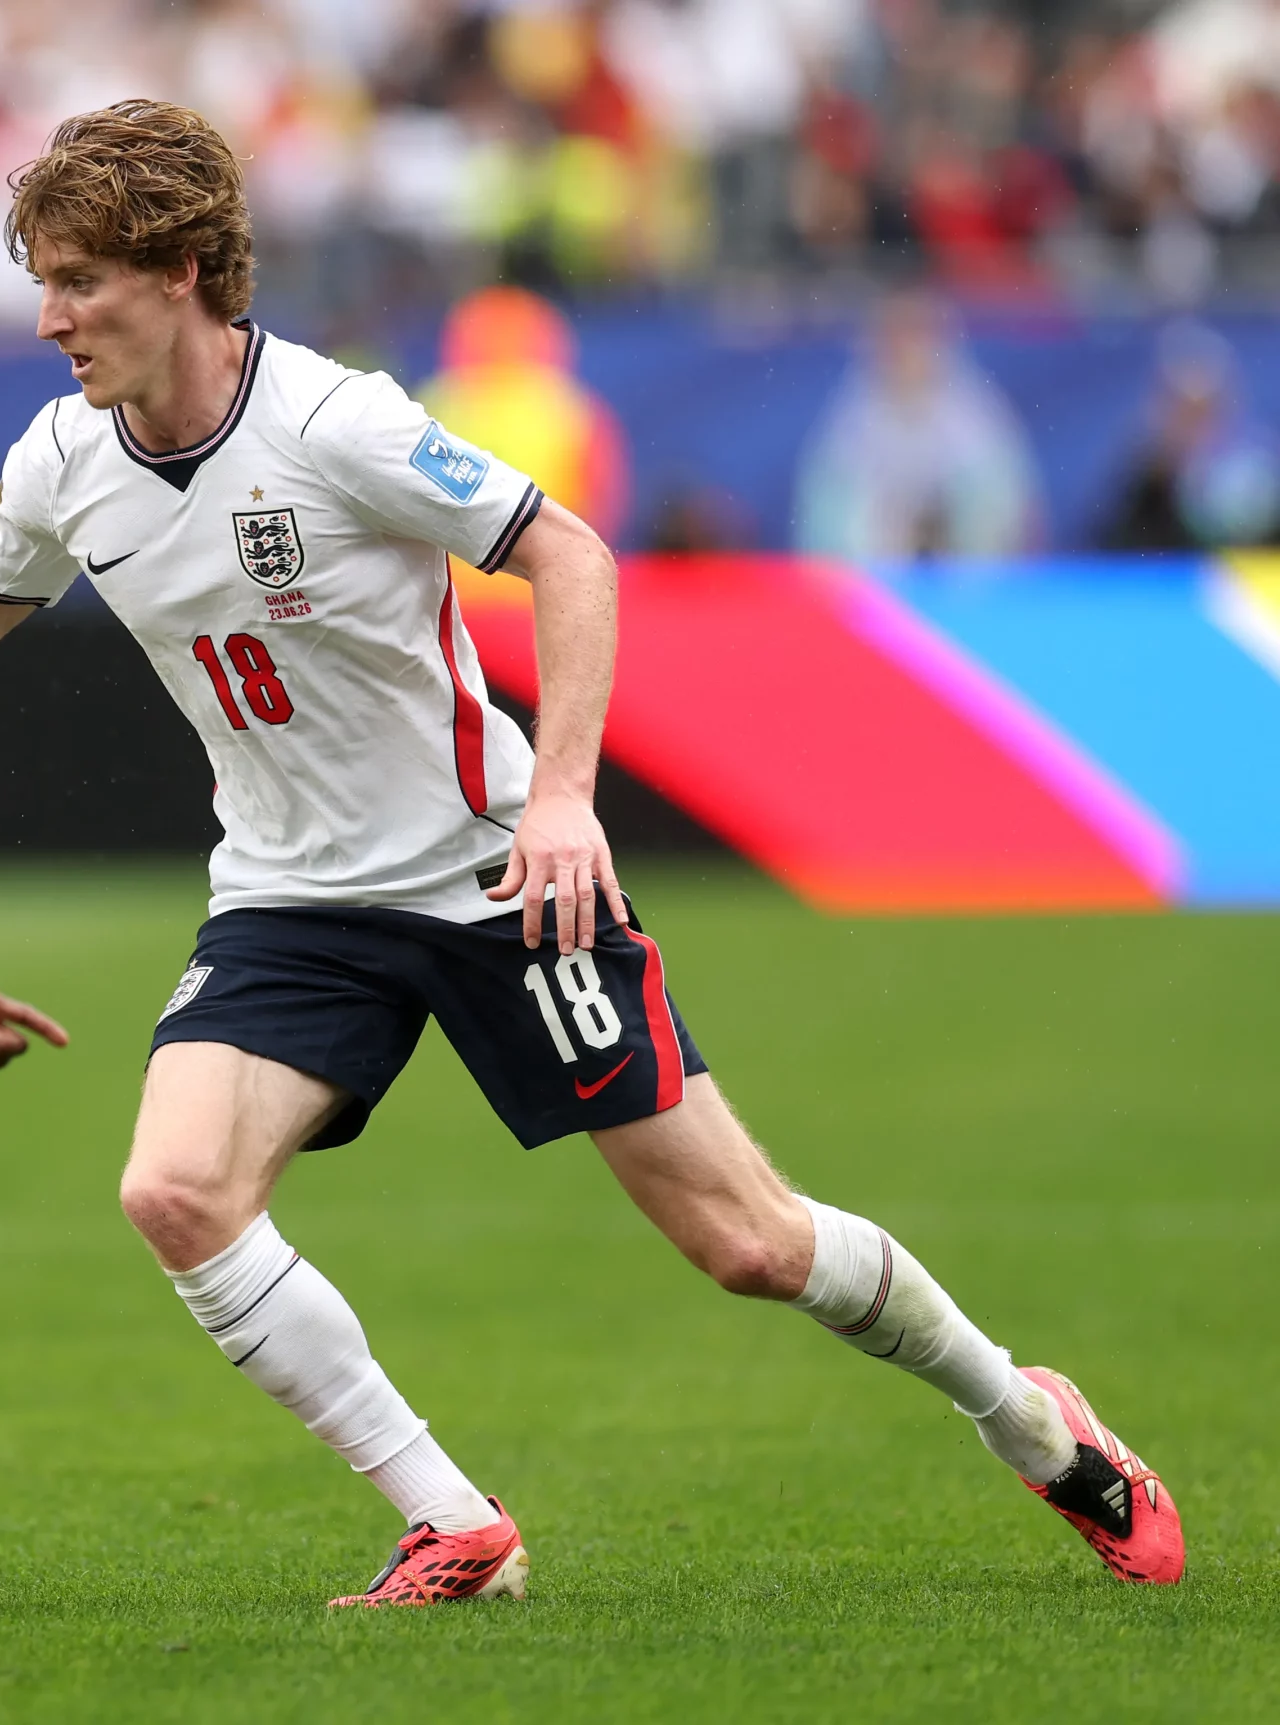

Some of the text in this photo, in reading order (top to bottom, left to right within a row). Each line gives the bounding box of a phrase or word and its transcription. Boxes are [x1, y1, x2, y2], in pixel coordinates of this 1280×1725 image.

[452, 456, 473, 484] PEACE
[264, 590, 306, 606] GHANA
[268, 602, 312, 621] 23.06.26
[192, 633, 294, 730] 18
[524, 947, 623, 1064] 18
